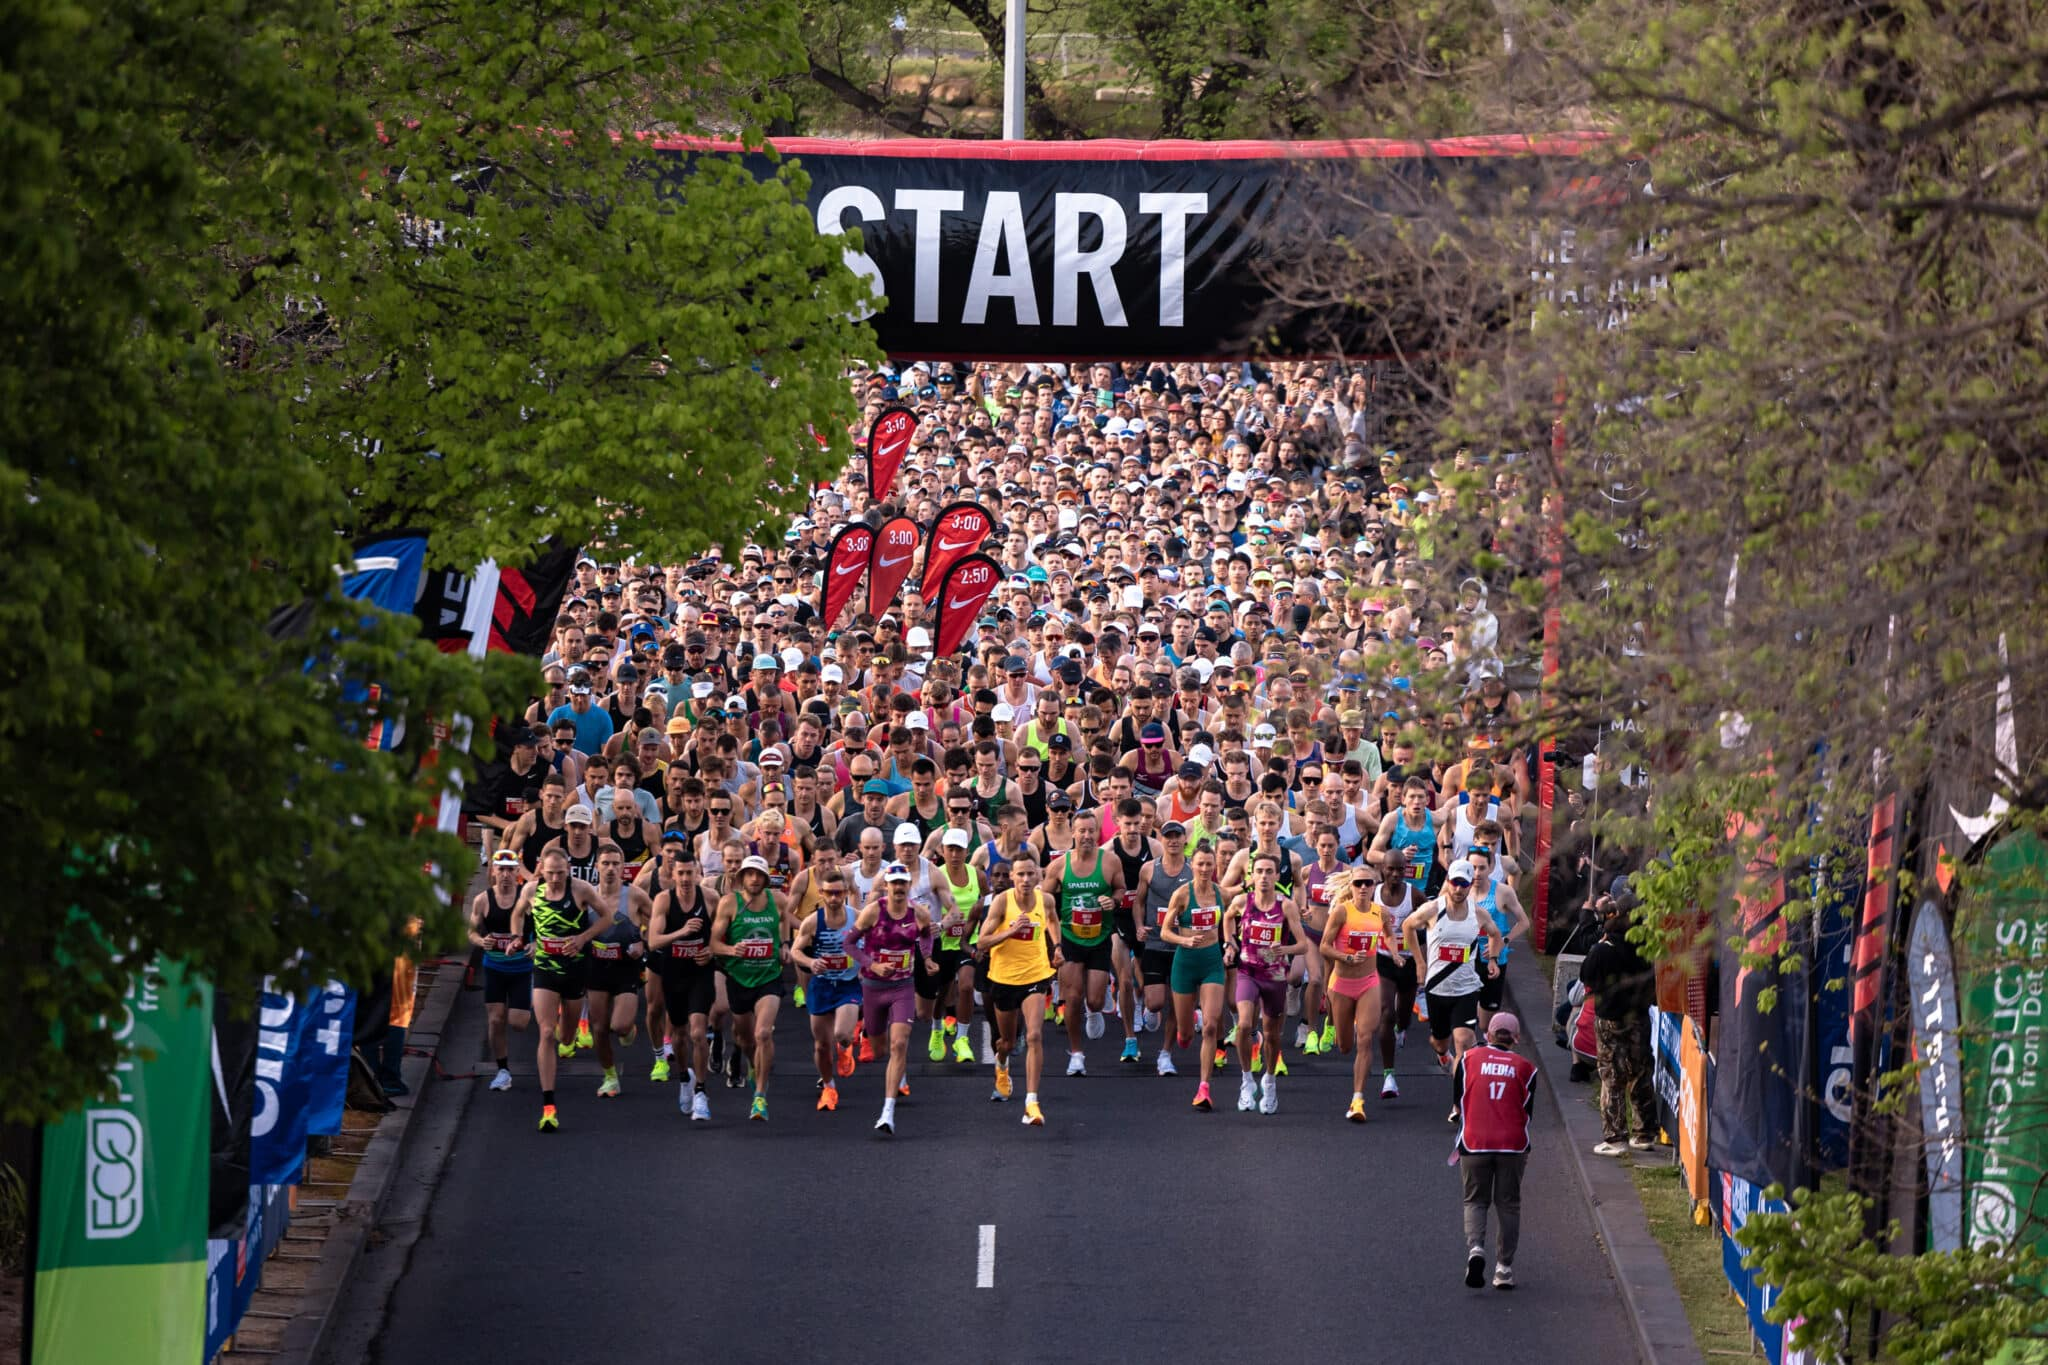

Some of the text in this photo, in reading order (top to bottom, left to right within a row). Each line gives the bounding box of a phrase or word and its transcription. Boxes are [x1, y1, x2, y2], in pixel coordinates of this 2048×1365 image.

[816, 185, 1209, 327] START
[885, 417, 906, 434] 3:10
[951, 515, 981, 531] 3:00
[889, 530, 913, 545] 3:00
[960, 567, 989, 585] 2:50
[1067, 881, 1100, 889] SPARTAN
[743, 915, 775, 924] SPARTAN
[1259, 928, 1272, 940] 46
[747, 945, 769, 957] 7757
[2017, 919, 2048, 1088] from Detak
[1481, 1062, 1516, 1078] MEDIA
[1489, 1080, 1506, 1100] 17
